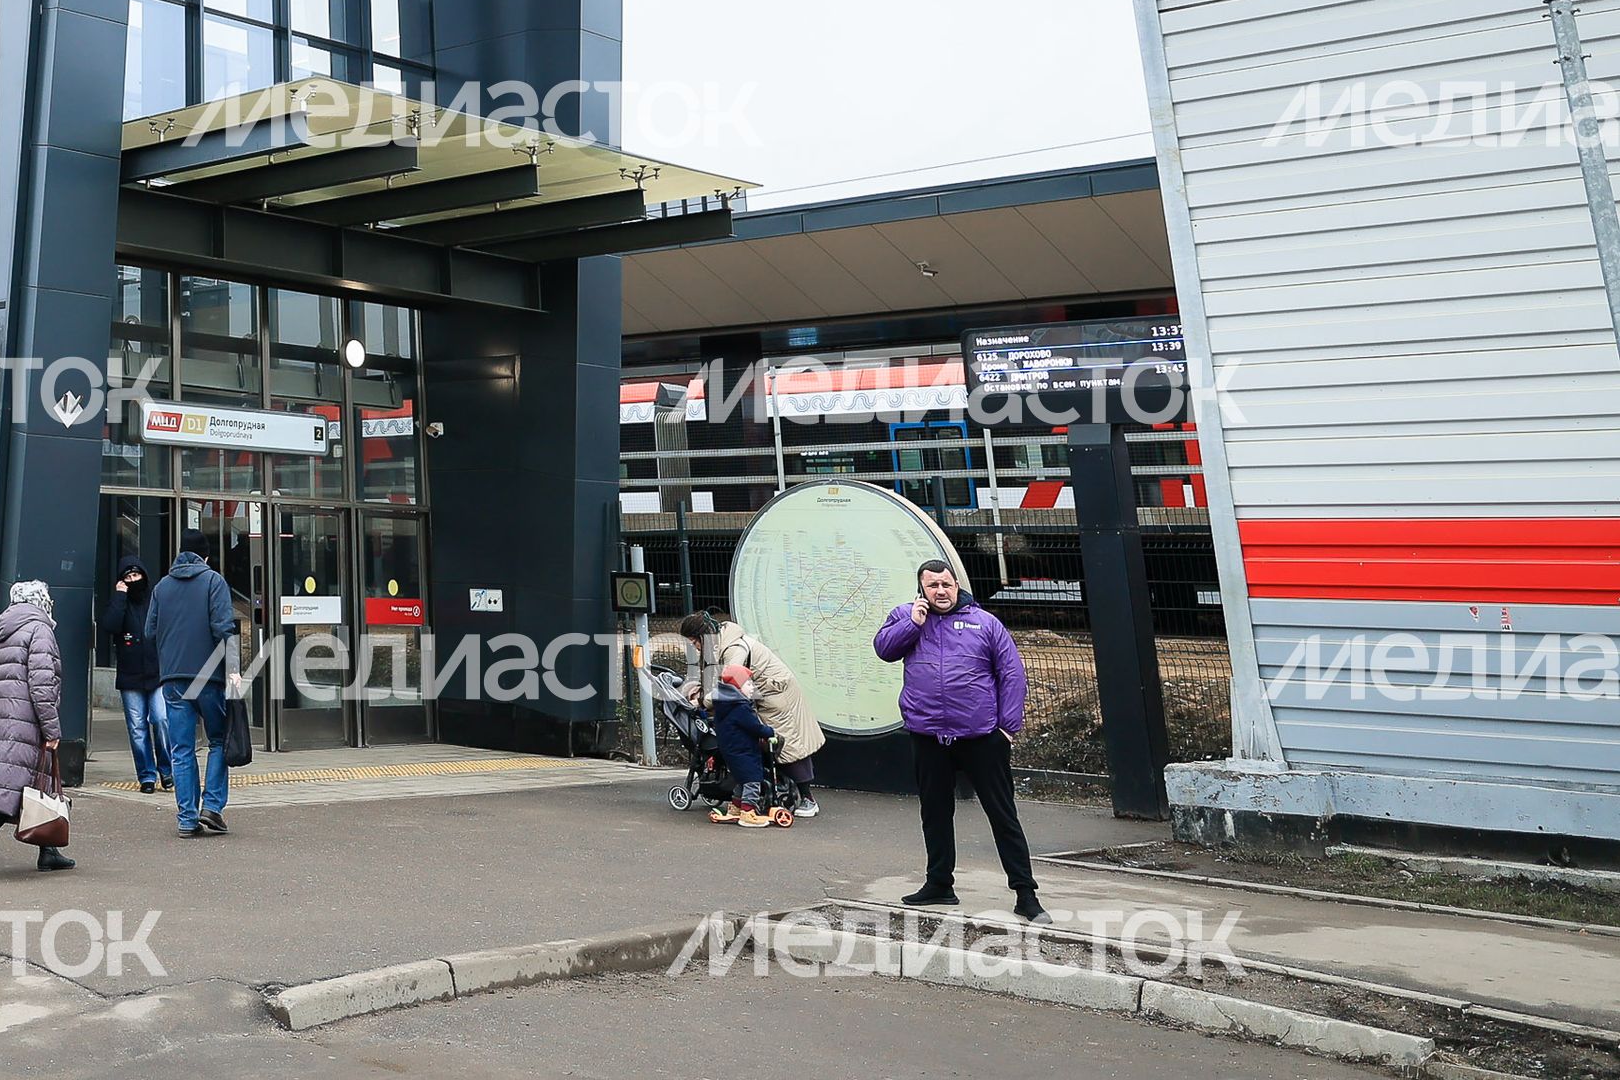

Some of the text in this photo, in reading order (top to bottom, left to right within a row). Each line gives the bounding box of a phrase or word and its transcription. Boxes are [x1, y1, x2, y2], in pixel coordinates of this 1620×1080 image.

[976, 335, 1030, 346] Назначение
[976, 341, 1181, 361] 6125 ДОРОХОВО 13:39
[1155, 364, 1184, 374] 13:45
[984, 383, 1032, 392] Остановки
[1037, 382, 1048, 390] по
[1053, 381, 1076, 389] всем
[187, 416, 203, 431] D1
[209, 416, 266, 432] Долгопрудная
[210, 428, 253, 440] Dolgoprudnaya
